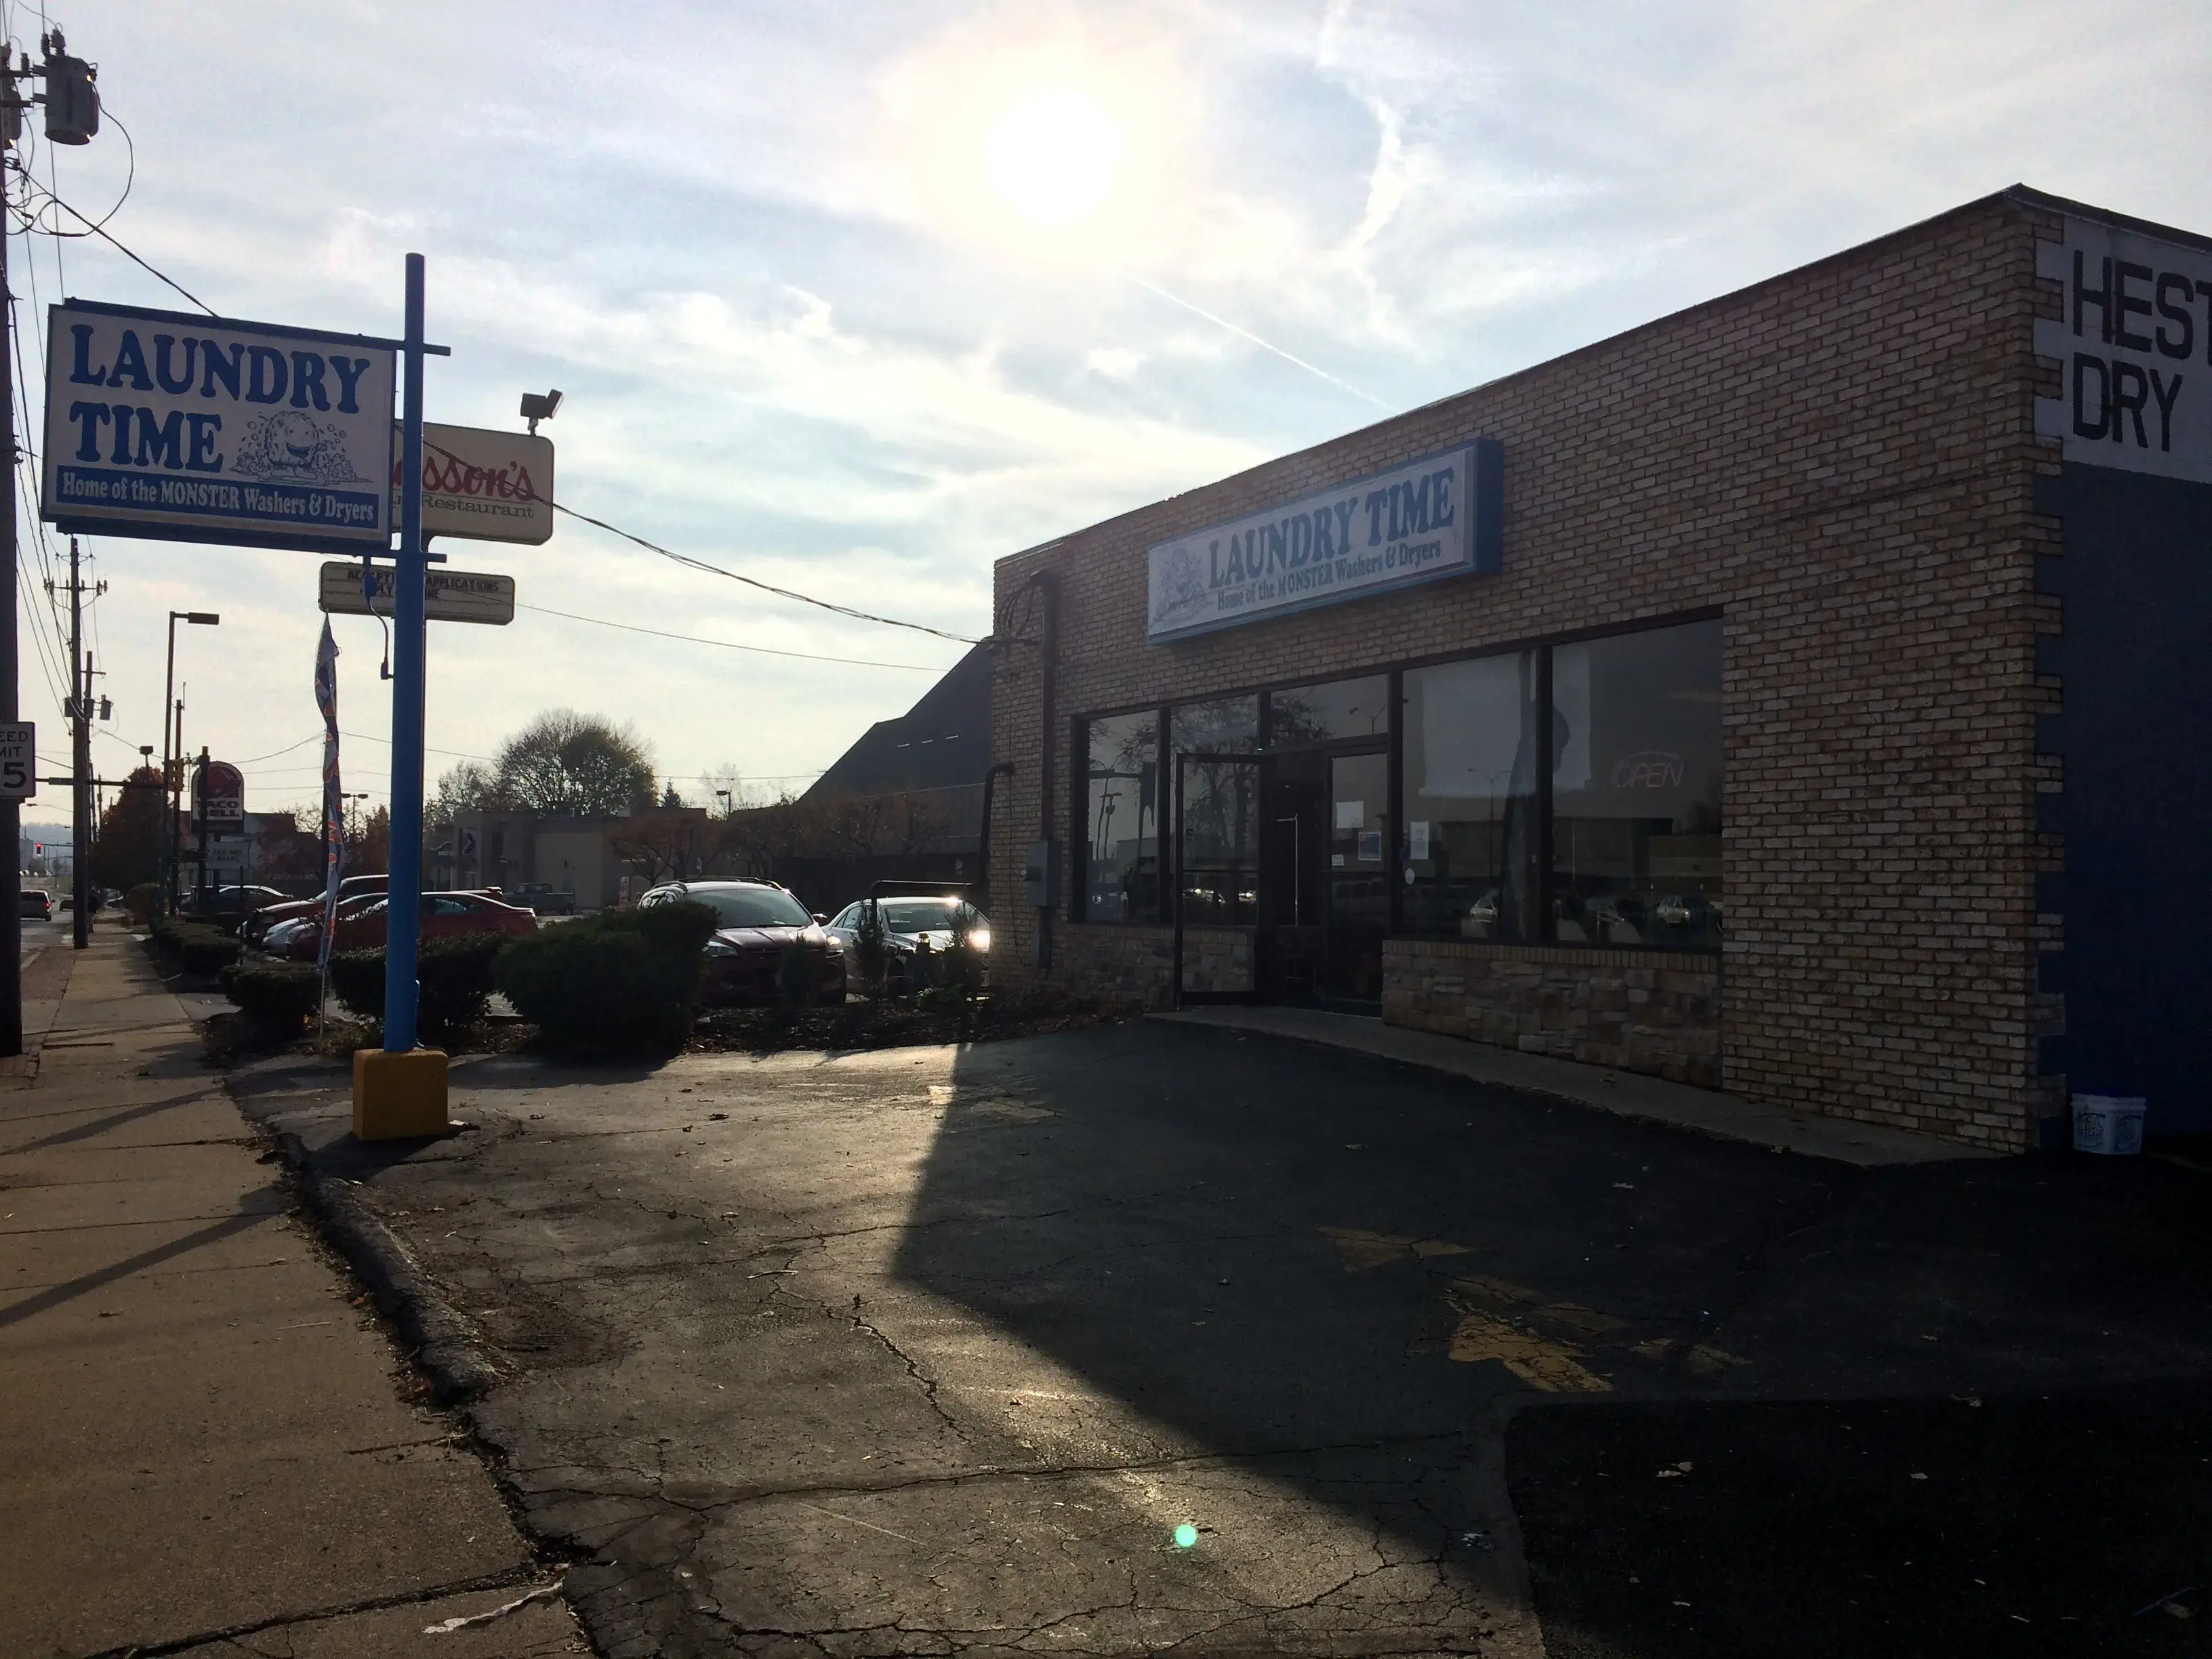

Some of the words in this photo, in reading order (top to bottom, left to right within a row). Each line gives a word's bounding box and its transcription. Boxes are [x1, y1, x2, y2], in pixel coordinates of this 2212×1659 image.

[69, 324, 370, 413] LAUNDRY
[2072, 351, 2184, 453] DRY
[69, 401, 224, 473] TIME
[63, 472, 108, 498] Home
[111, 477, 128, 499] of
[131, 478, 157, 502] the
[161, 480, 240, 510] MONSTER
[244, 487, 305, 515] Washers
[309, 493, 322, 516] &
[325, 495, 373, 524] Dryers
[393, 456, 535, 501] sson's
[421, 495, 535, 518] Restaurant
[1208, 497, 1358, 590] LAUNDRY
[1366, 466, 1454, 547] TIME
[426, 575, 499, 591] APPLICATIONS
[1218, 590, 1244, 610] Home
[1246, 581, 1256, 603] of
[1258, 580, 1275, 600] the
[1278, 562, 1334, 597] MONSTER
[1336, 555, 1383, 582] Washers
[1386, 546, 1396, 569] &
[1399, 540, 1441, 568] Dryers
[1614, 760, 1685, 787] OPEN
